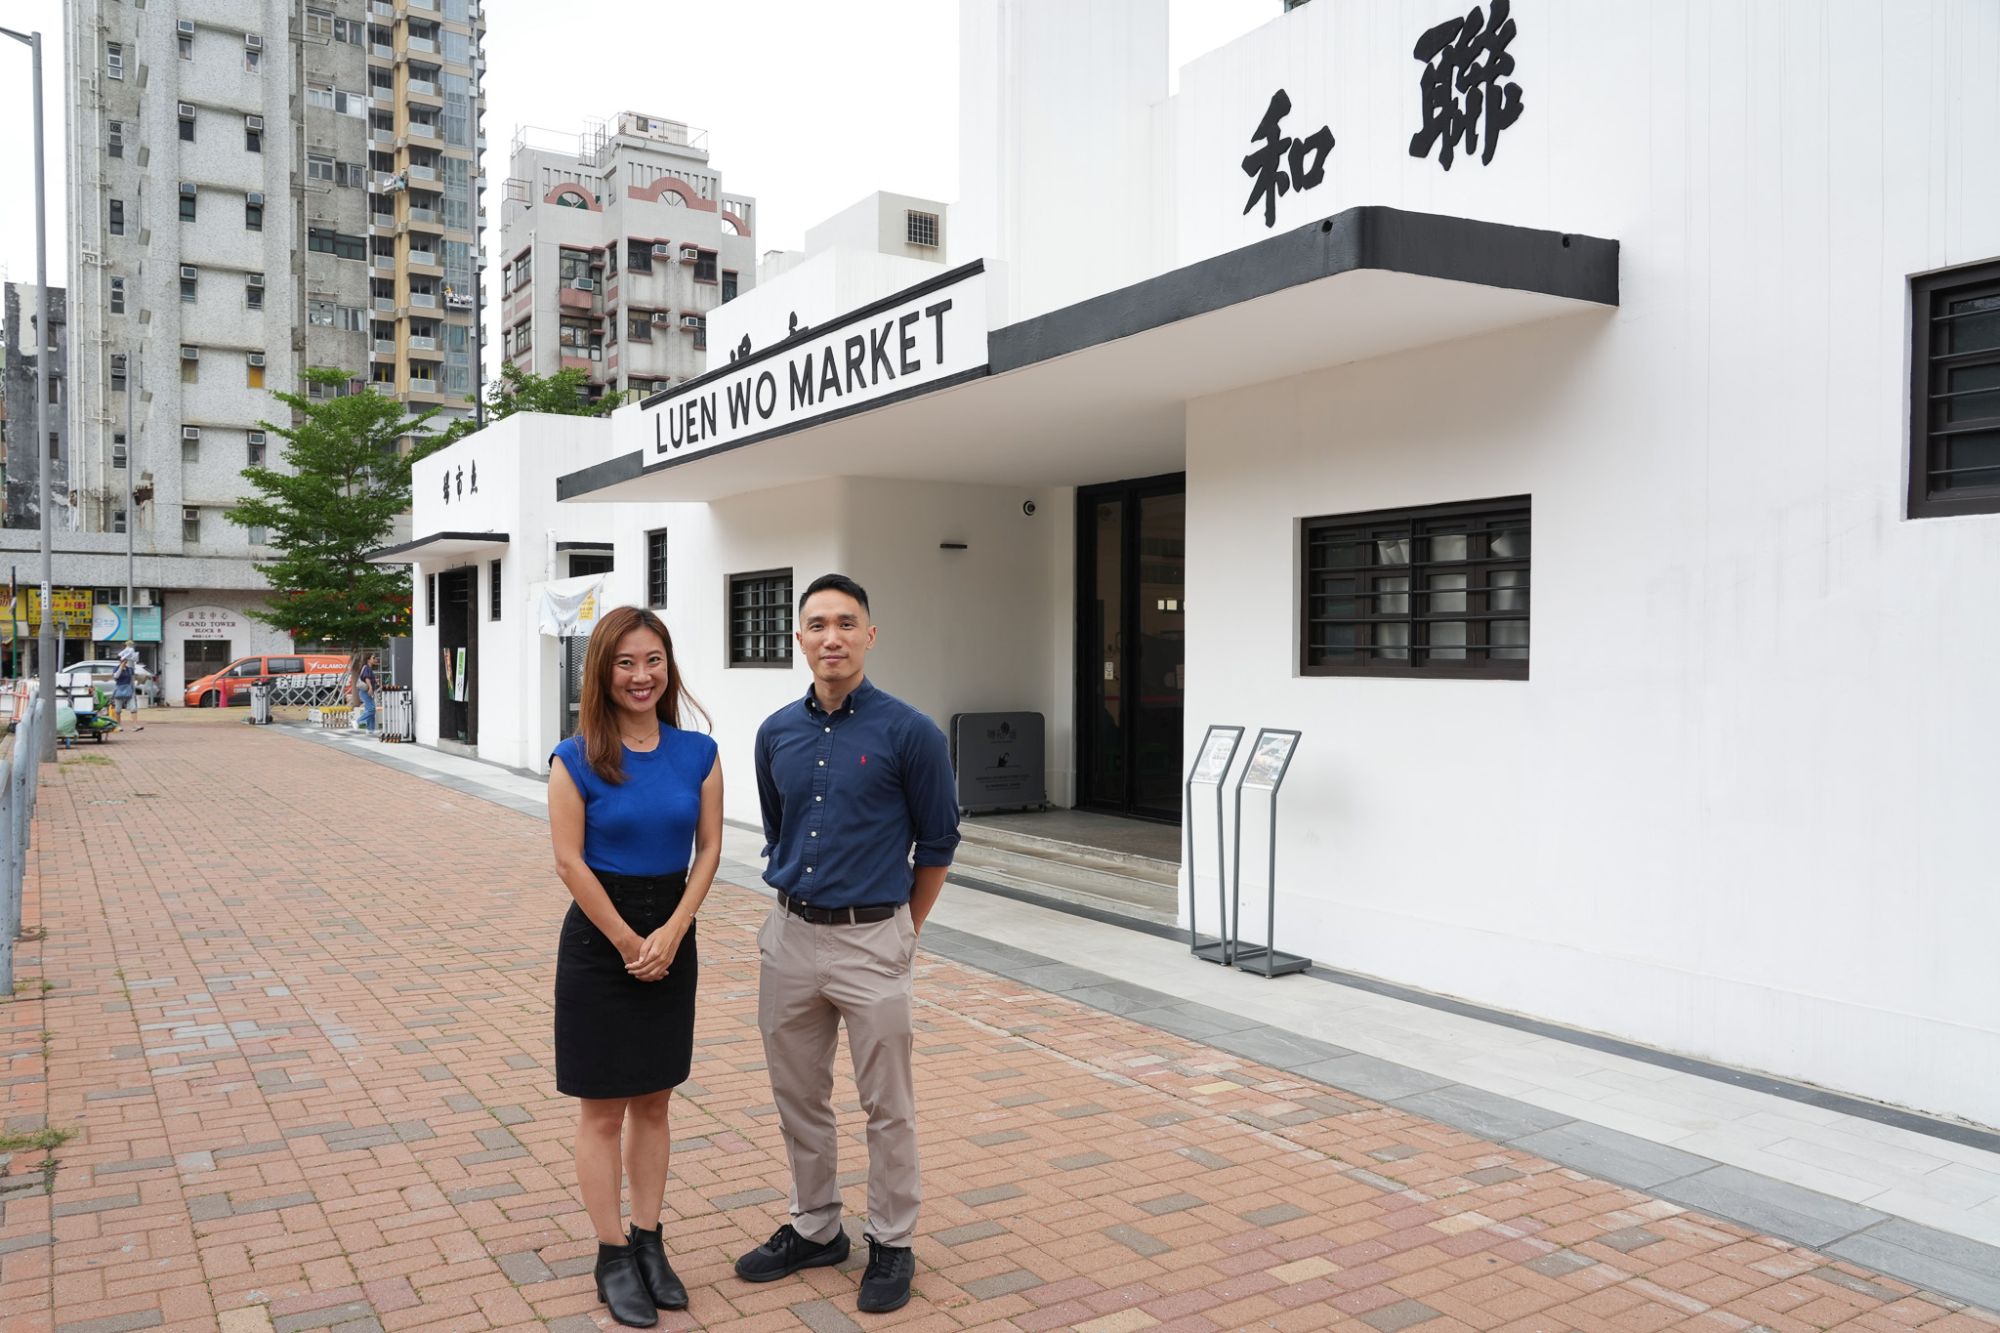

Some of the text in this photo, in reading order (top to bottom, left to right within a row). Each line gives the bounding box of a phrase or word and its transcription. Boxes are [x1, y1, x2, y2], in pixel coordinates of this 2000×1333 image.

[656, 392, 717, 454] LUEN
[727, 370, 777, 430] WO
[789, 298, 953, 412] MARKET
